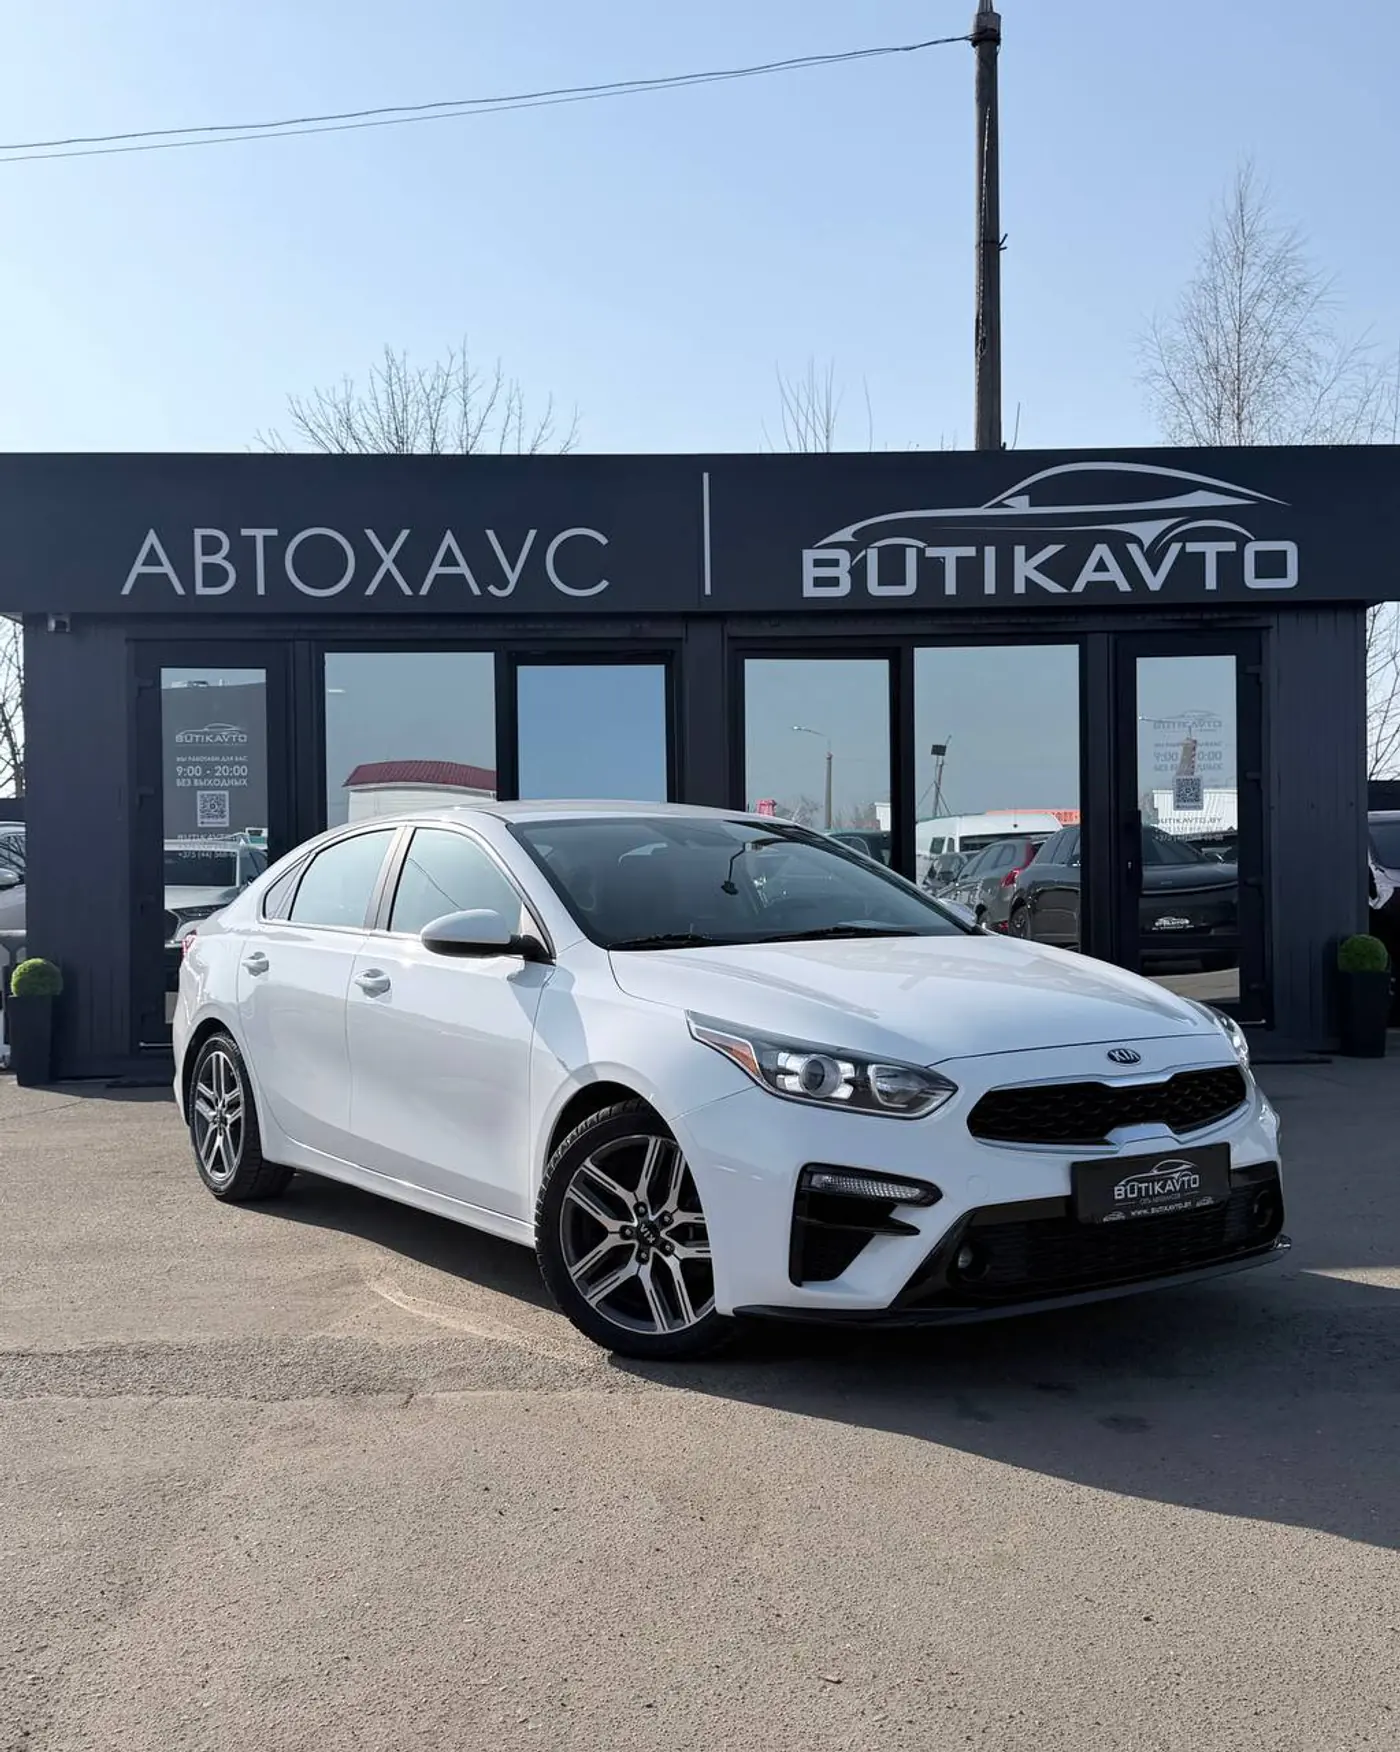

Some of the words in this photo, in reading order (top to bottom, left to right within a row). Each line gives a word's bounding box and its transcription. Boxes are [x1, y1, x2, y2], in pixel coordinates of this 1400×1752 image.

[121, 527, 609, 597] АВТОХАУС
[802, 540, 1299, 598] BUTIKAVTO
[175, 733, 248, 743] BUTIKAVTO
[176, 765, 202, 777] 9:00
[214, 765, 248, 776] 20:00
[1114, 1174, 1200, 1200] BUTIKAVTO
